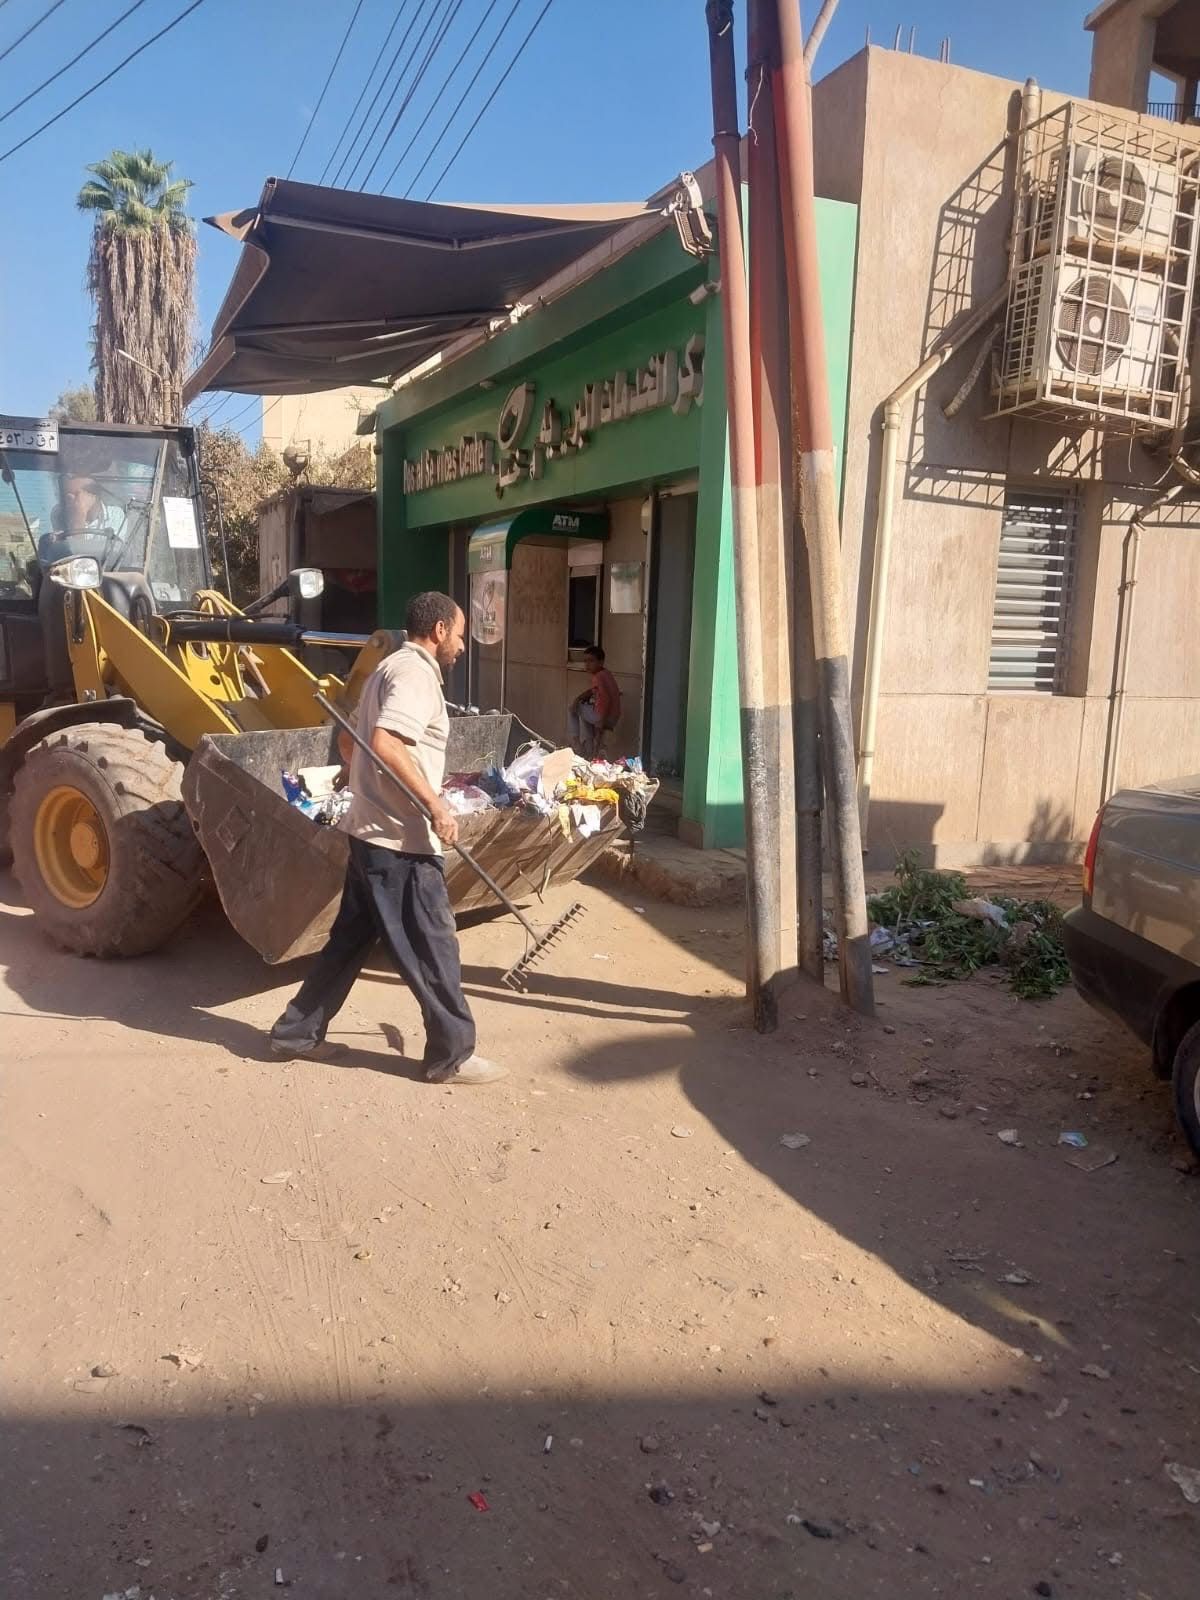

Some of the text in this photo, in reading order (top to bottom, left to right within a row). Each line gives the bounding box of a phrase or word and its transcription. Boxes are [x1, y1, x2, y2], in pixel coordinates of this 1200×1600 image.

[403, 448, 424, 495] Posal
[425, 445, 457, 488] Sevices
[459, 432, 491, 478] Cente
[552, 514, 580, 530] ATM
